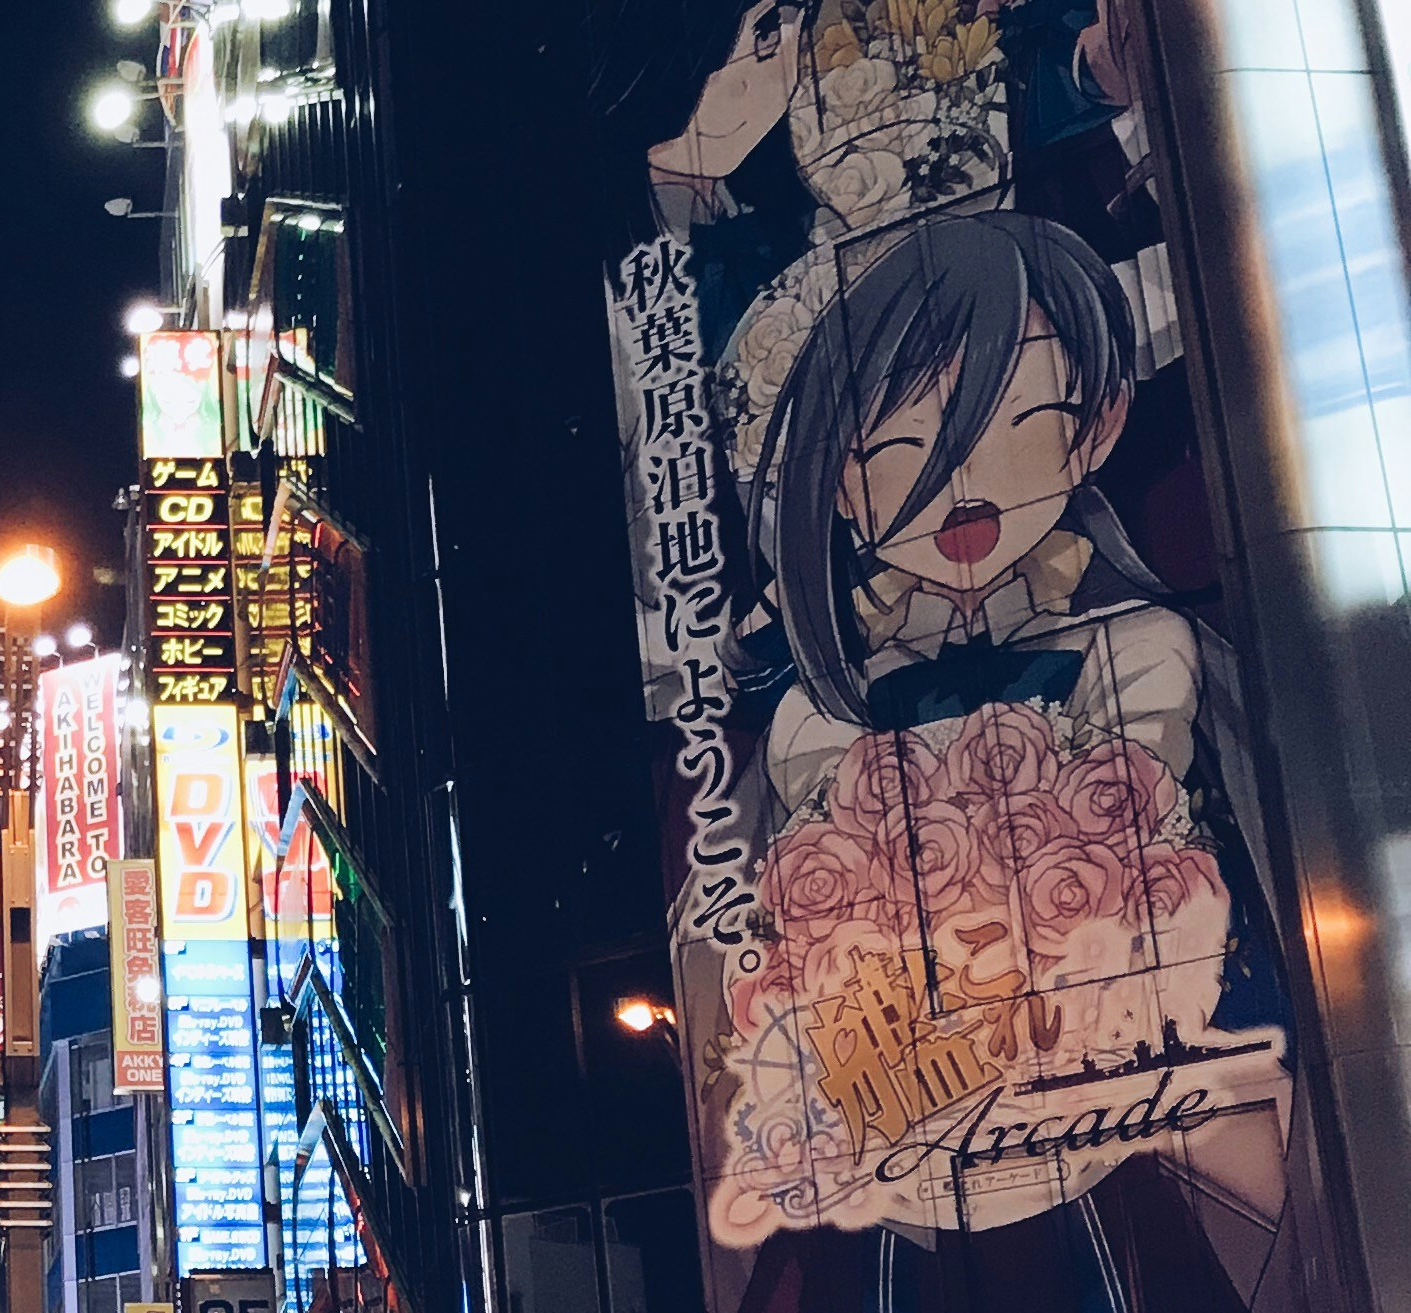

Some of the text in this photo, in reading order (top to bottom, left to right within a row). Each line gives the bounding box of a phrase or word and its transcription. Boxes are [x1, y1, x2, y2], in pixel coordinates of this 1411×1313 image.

[152, 461, 219, 487] ゲーム
[159, 495, 213, 522] CD
[153, 531, 223, 558] アイドル
[154, 565, 225, 592] アニメ
[156, 602, 224, 629] コミック
[161, 638, 223, 665] ホビー
[158, 675, 227, 702] フィギュア
[56, 690, 79, 881] AKIHABARA
[84, 672, 108, 875] WELCOME TO
[122, 1053, 163, 1067] AKKY
[127, 1068, 163, 1082] ONE
[875, 1071, 1218, 1183] Arcade
